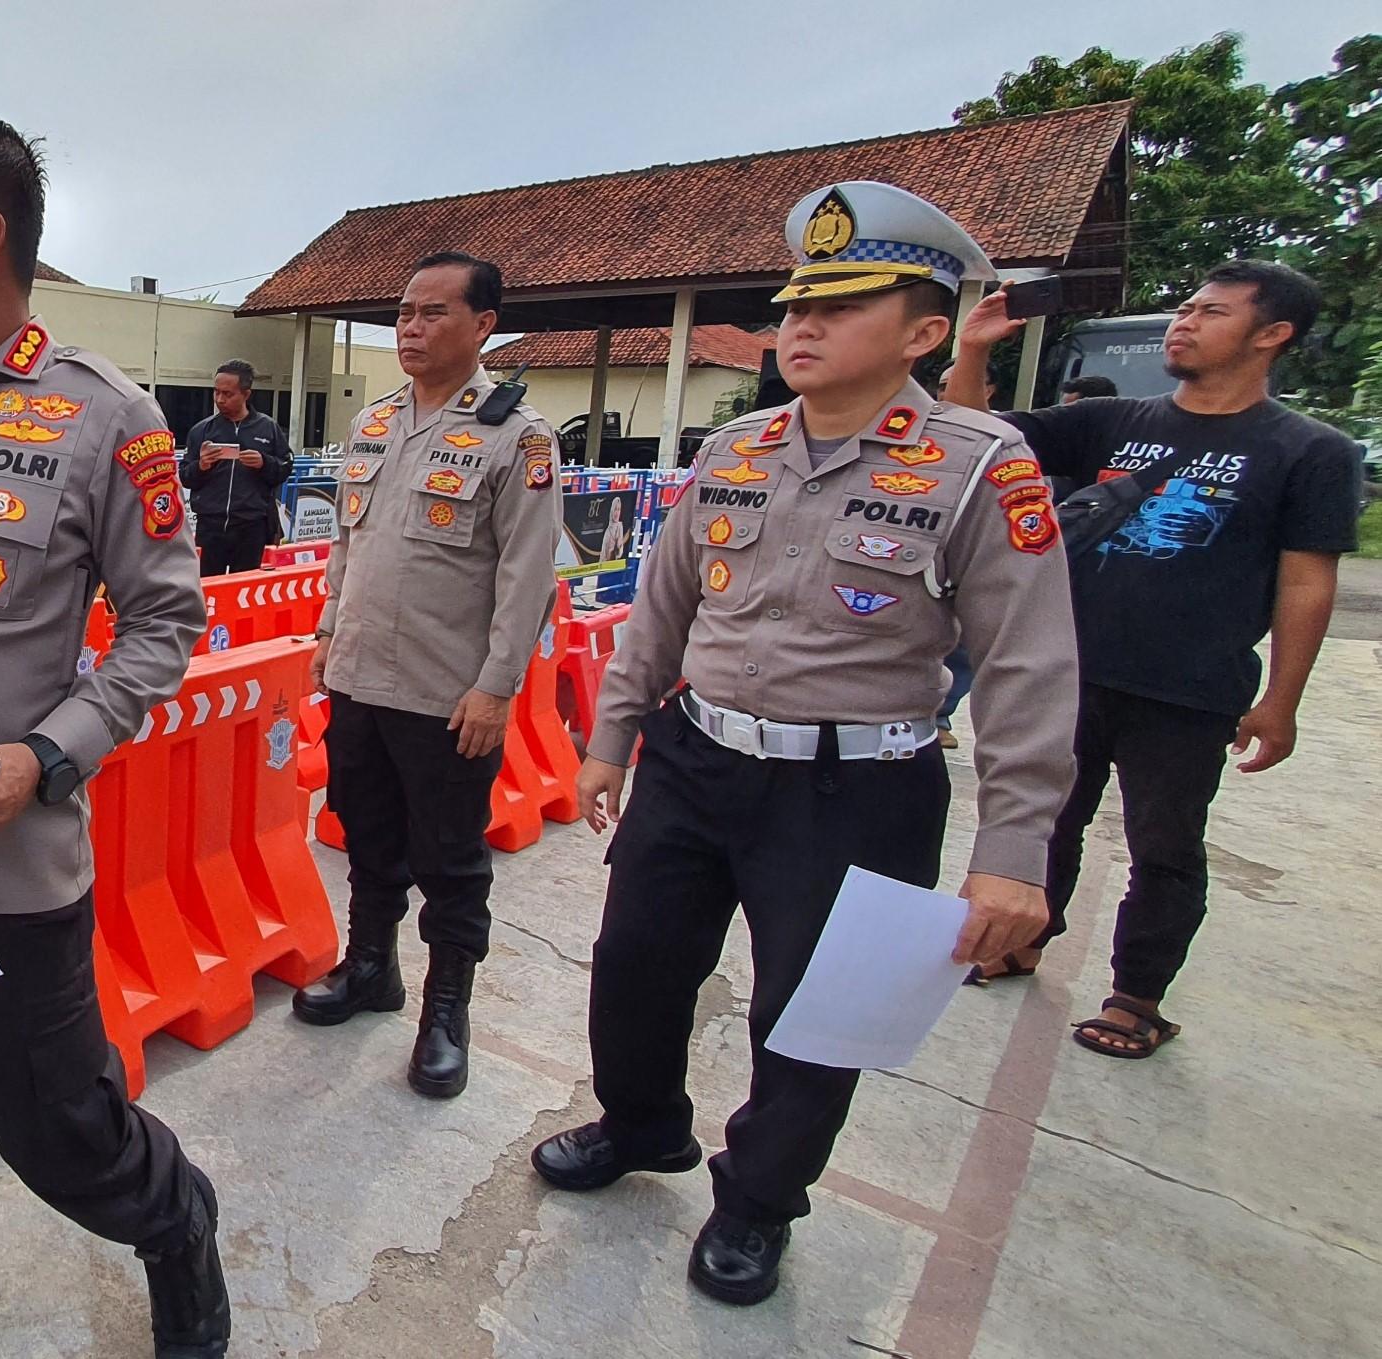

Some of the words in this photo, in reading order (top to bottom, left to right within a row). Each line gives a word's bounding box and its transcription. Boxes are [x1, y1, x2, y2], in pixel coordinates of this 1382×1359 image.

[120, 432, 172, 460] POLRESTA
[430, 450, 482, 468] POLRI
[1114, 441, 1247, 471] JURLIS
[698, 486, 768, 509] WIBOWO
[843, 498, 942, 531] POLRI
